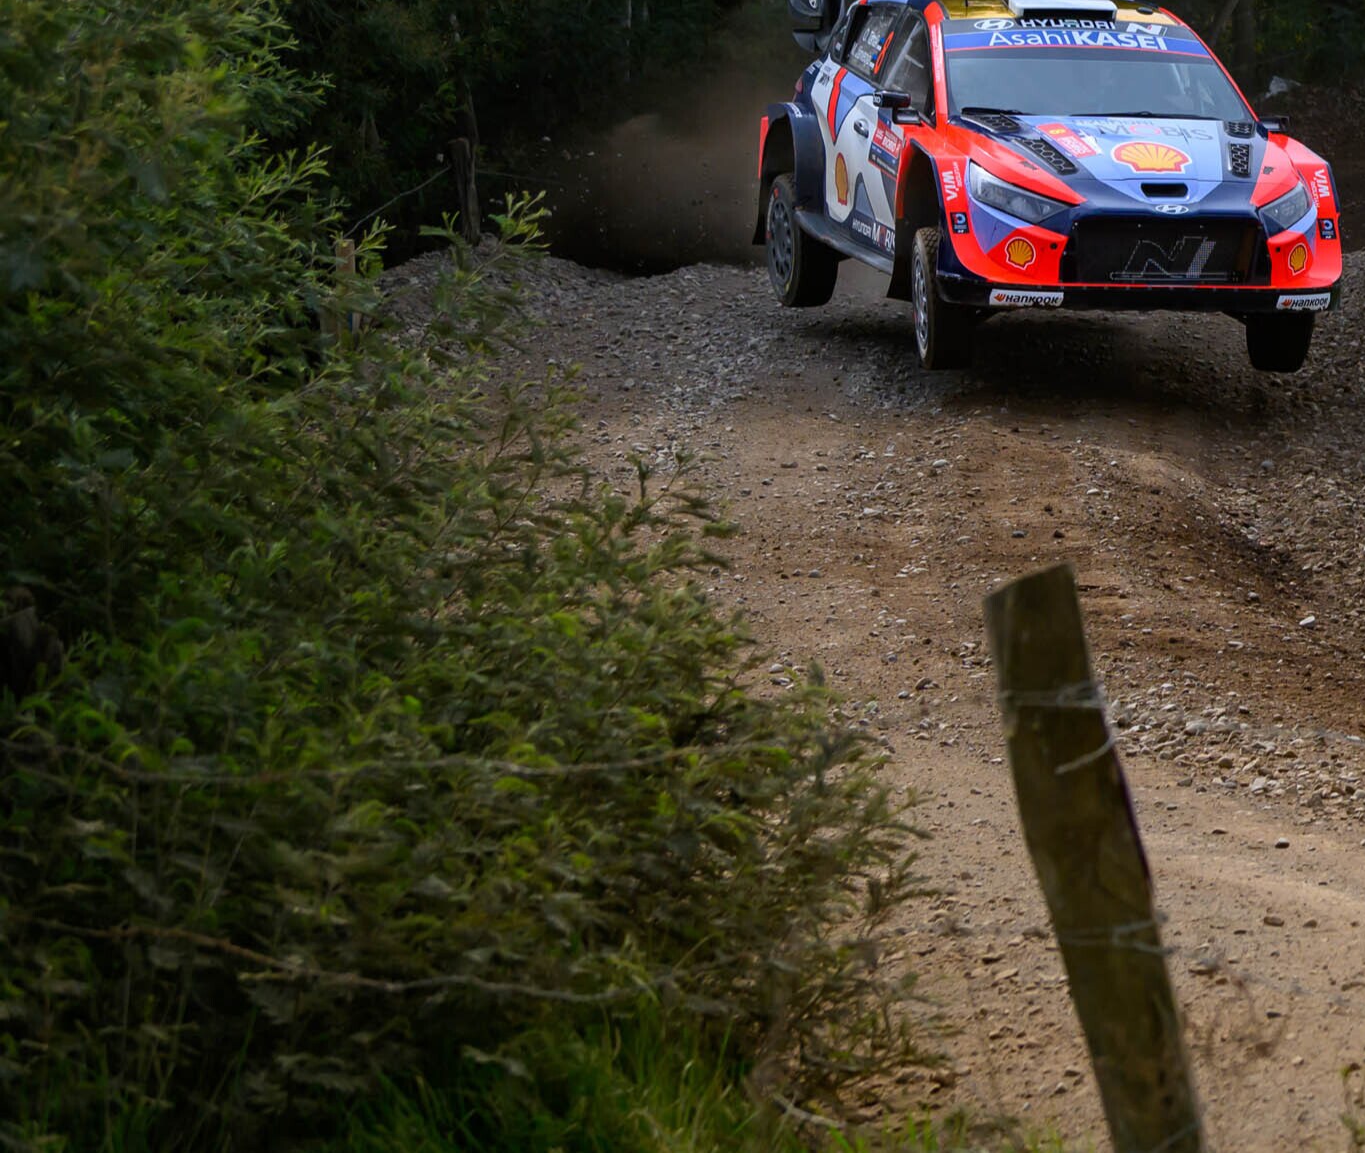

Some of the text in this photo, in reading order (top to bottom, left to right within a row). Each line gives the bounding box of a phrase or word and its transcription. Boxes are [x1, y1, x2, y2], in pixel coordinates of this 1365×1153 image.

[1021, 19, 1116, 30] HYUNDAI
[873, 30, 894, 75] 8
[1096, 124, 1214, 140] MOBIS
